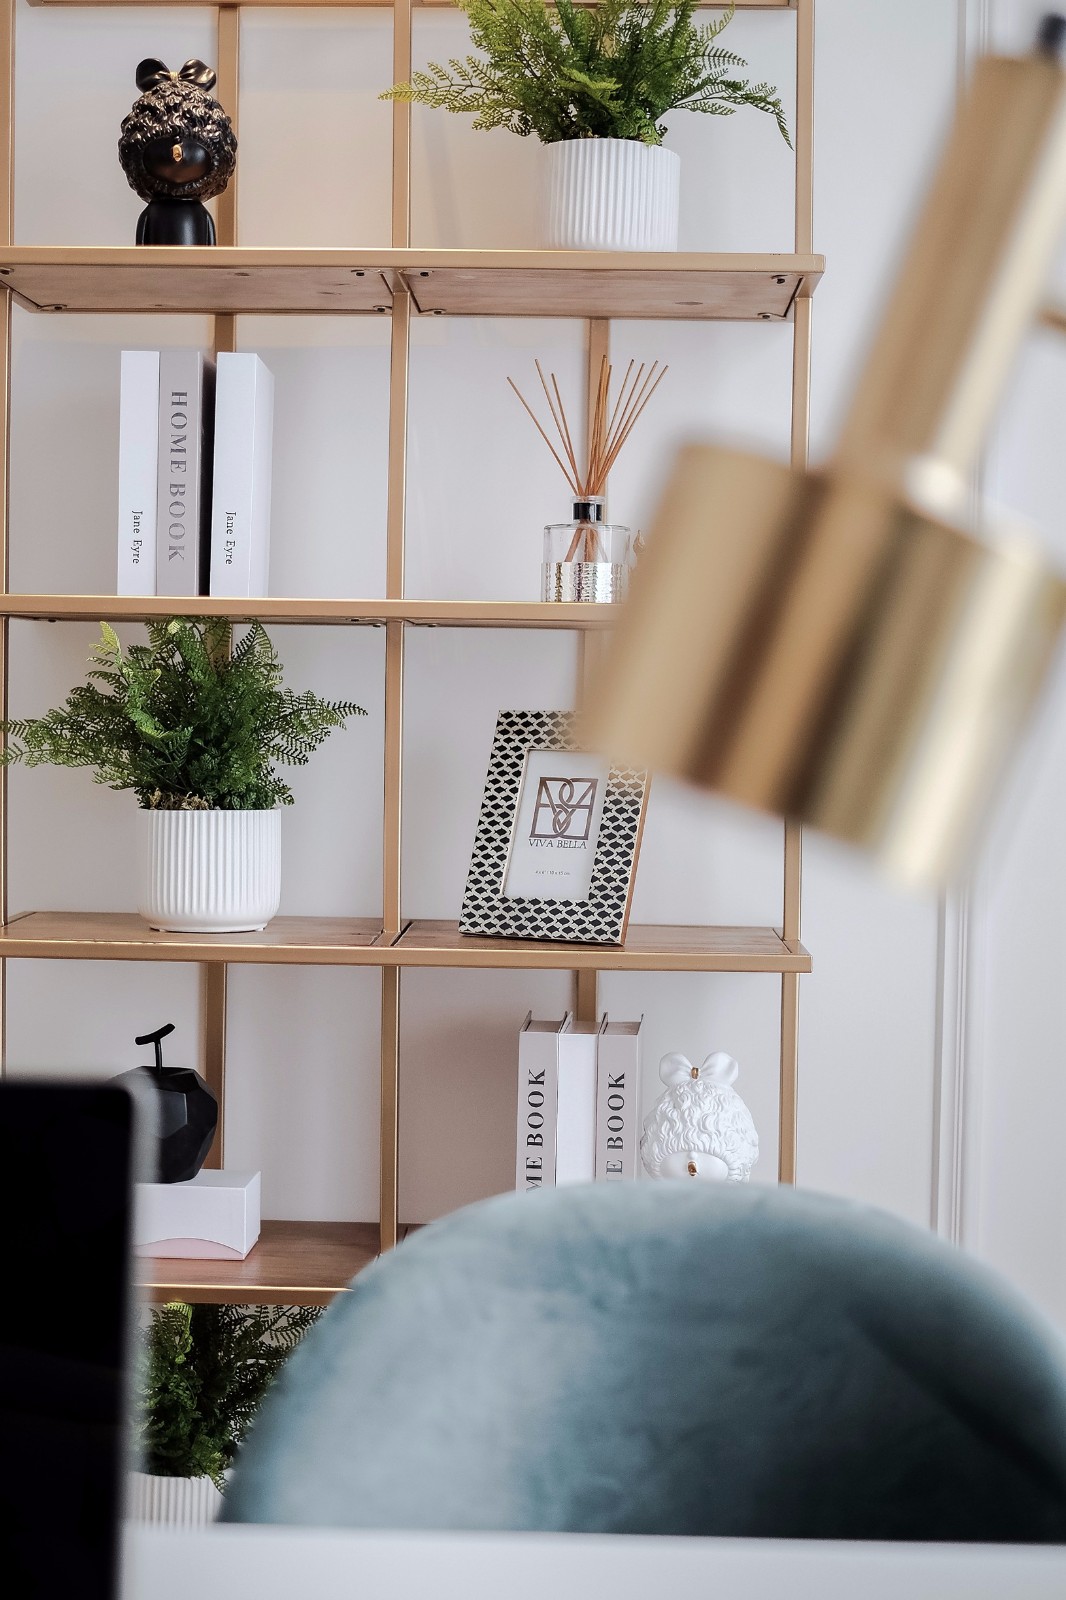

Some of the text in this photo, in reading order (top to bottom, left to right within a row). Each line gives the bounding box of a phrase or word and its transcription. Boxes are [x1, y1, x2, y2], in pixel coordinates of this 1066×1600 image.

[168, 391, 188, 561] HOME BOOK
[131, 511, 143, 564] Jane Eyre
[224, 511, 237, 565] Jane Eyre
[528, 838, 588, 850] VIVA BELLA
[525, 1069, 546, 1194] ME BOOK
[607, 1072, 626, 1151] BOOK
